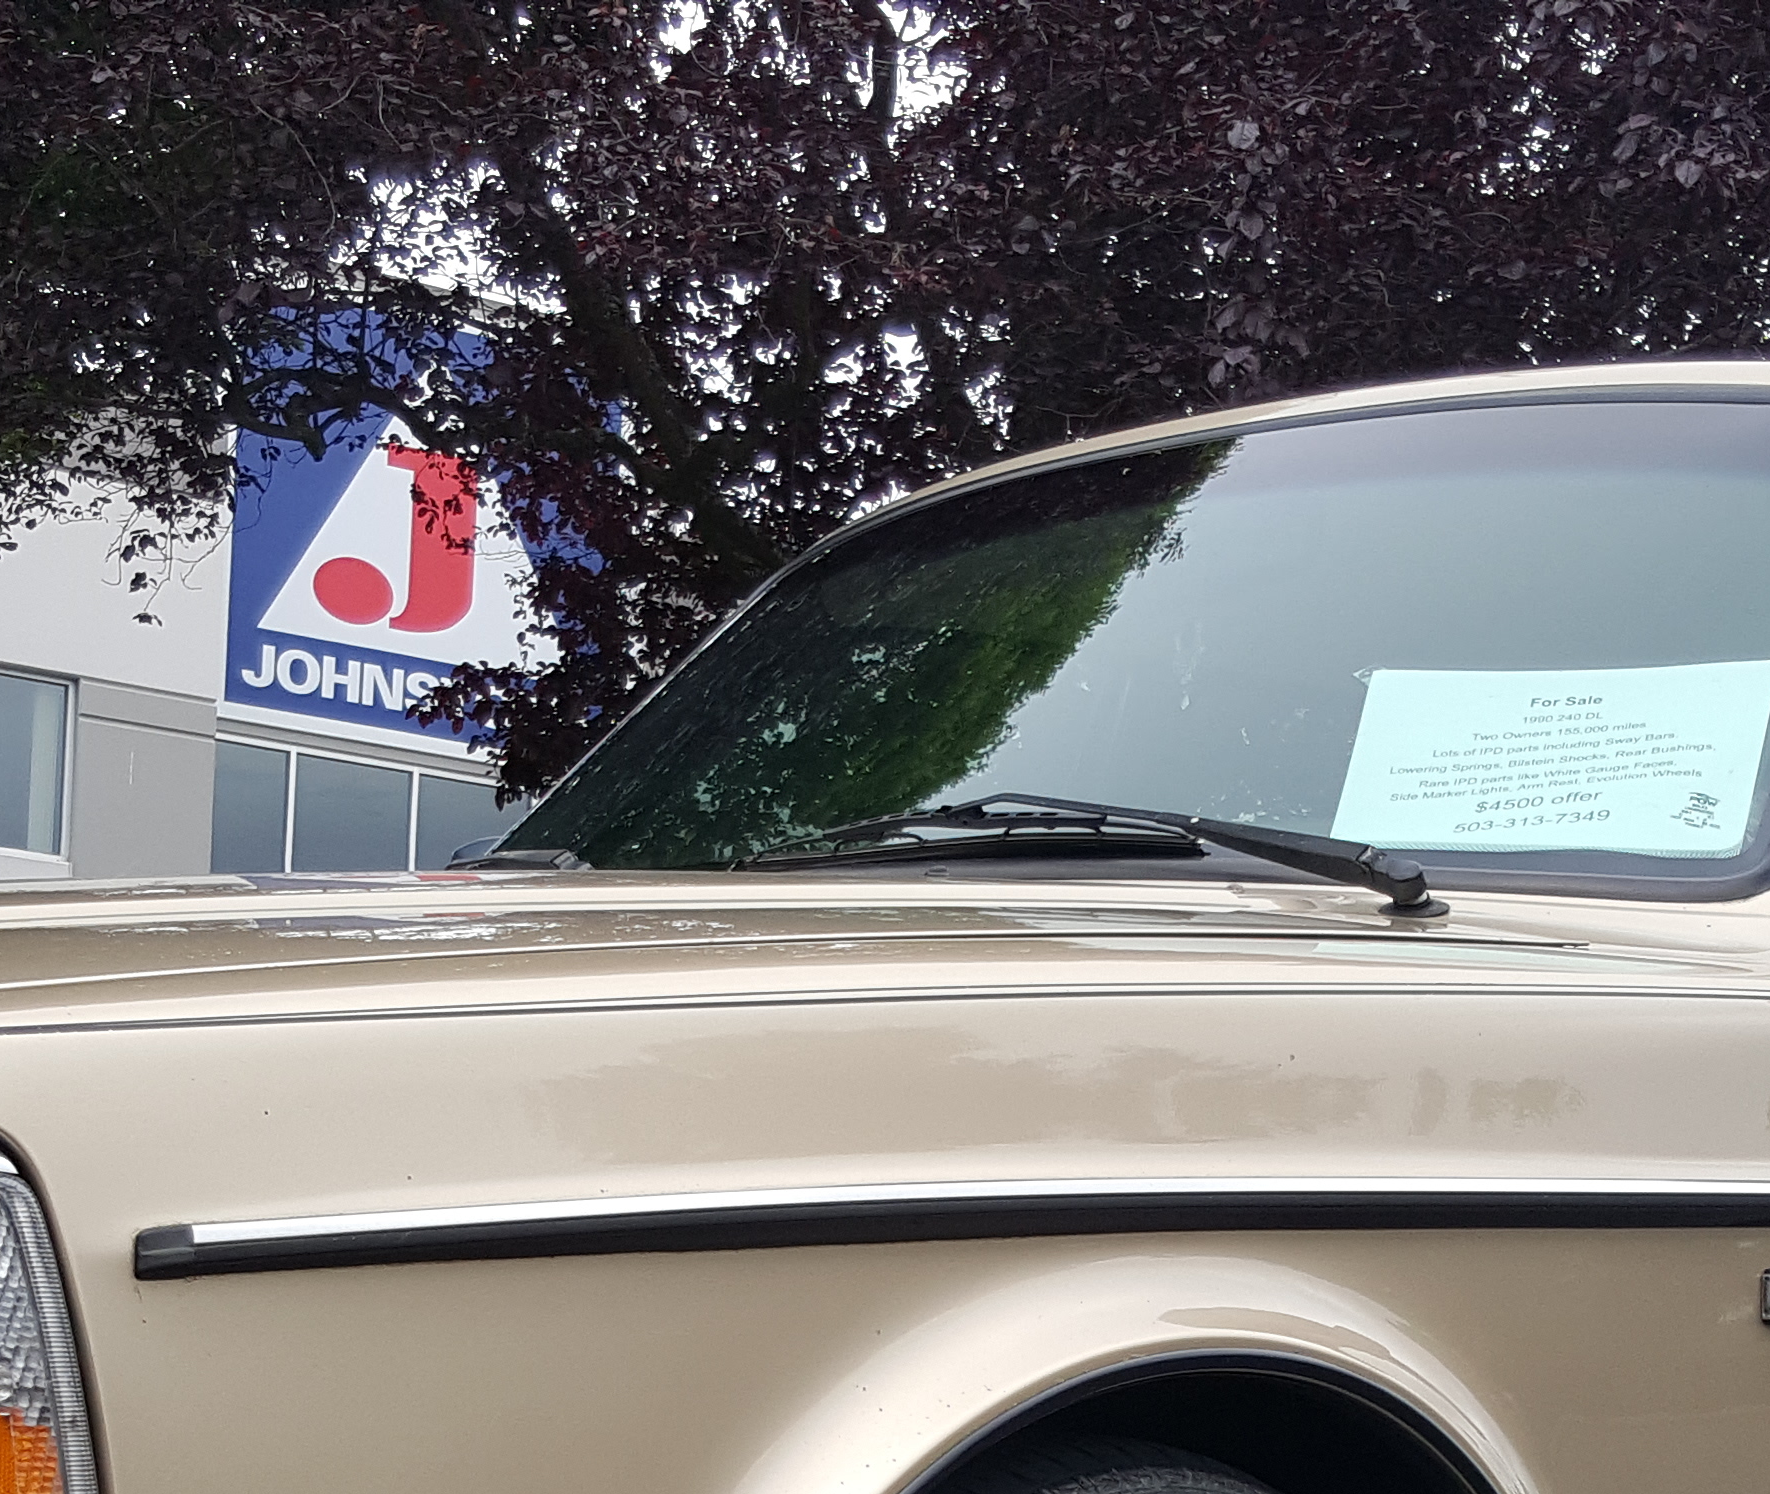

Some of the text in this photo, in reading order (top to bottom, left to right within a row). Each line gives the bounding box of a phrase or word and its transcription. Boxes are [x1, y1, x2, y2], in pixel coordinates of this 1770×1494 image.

[1530, 695, 1603, 708] For Sale
[1557, 713, 1582, 722] 240
[1585, 712, 1603, 720] DL
[1472, 733, 1498, 741] Two
[1503, 730, 1551, 740] Owners
[1612, 721, 1647, 731] miles
[1432, 749, 1460, 758] Lots
[1463, 748, 1476, 756] of
[1479, 746, 1504, 756] IPD
[1506, 744, 1540, 756] parts
[1543, 740, 1601, 751] including
[1605, 735, 1642, 746] Sway
[1389, 765, 1447, 775] Lowering
[1508, 757, 1554, 768] Bilstein
[1615, 749, 1647, 758] Rear
[1390, 792, 1419, 802] Side
[1422, 789, 1468, 800] Marker
[1517, 781, 1544, 791] Arm
[1587, 771, 1648, 784] Evolution
[1652, 768, 1703, 778] Wheels
[1419, 779, 1449, 789] Rare
[1454, 777, 1478, 786] IPD
[1481, 774, 1513, 786] parts
[1517, 772, 1540, 781] like
[1544, 768, 1581, 778] White
[1585, 763, 1630, 774] Gauge
[1475, 791, 1603, 813] $4500 offer
[1453, 809, 1611, 834] 503-313-7349
